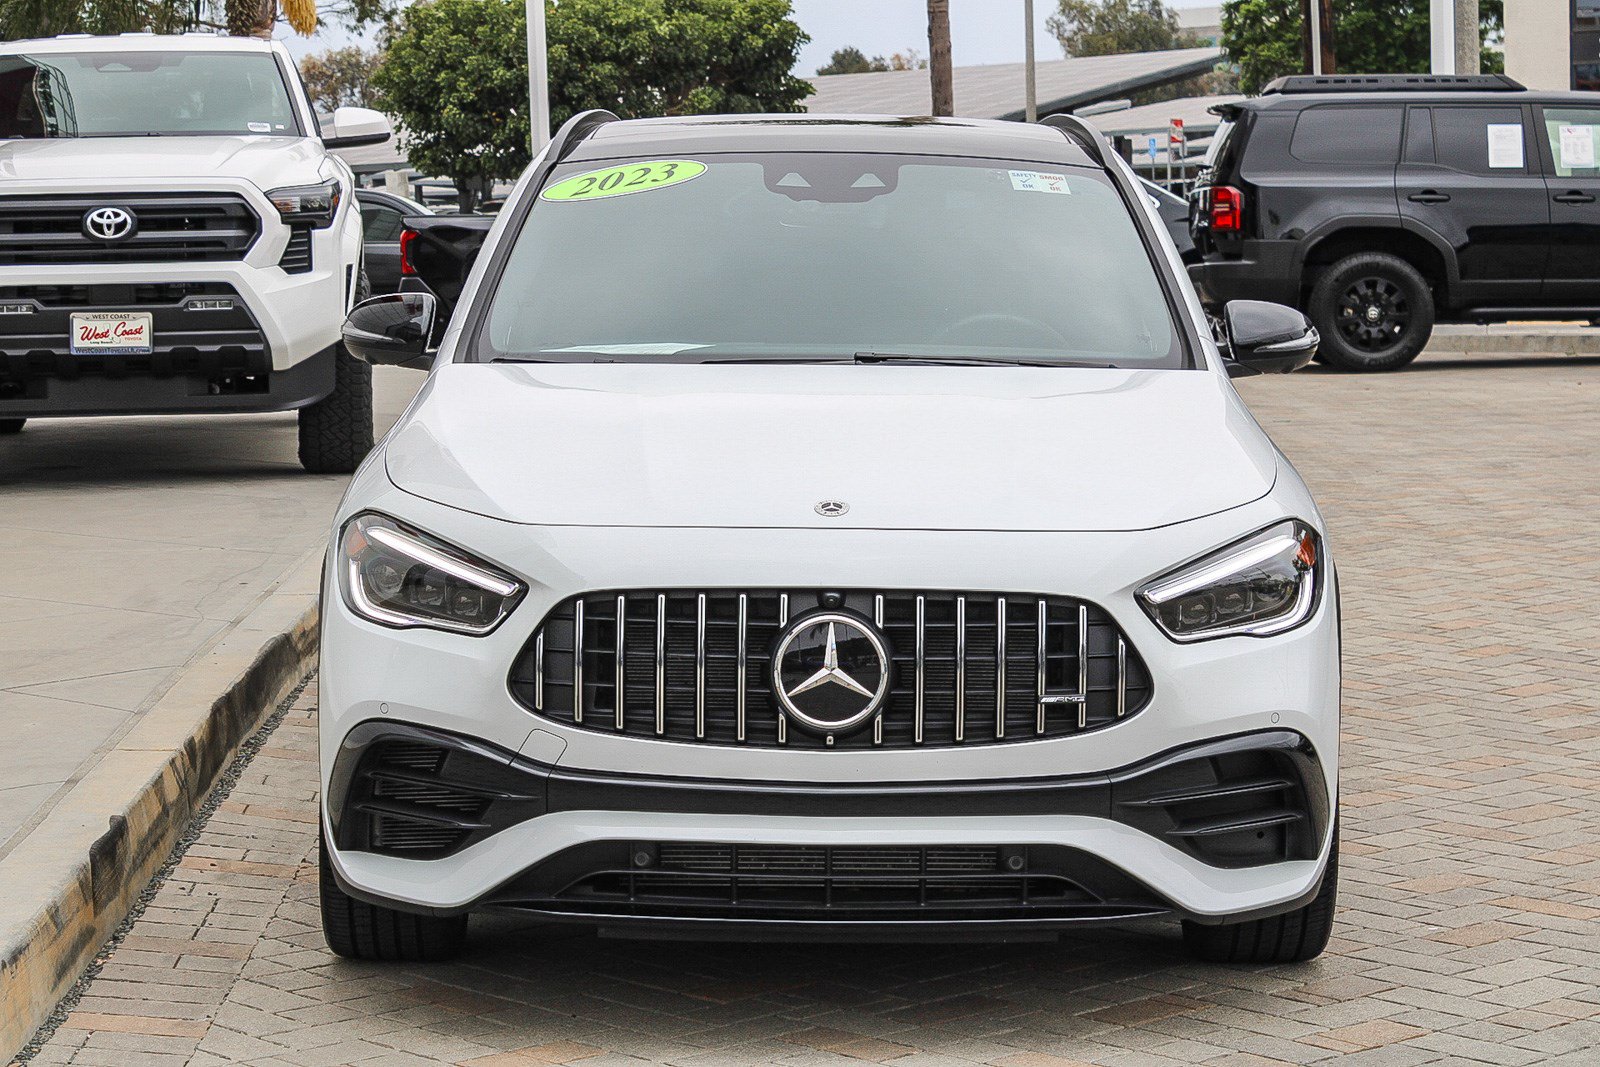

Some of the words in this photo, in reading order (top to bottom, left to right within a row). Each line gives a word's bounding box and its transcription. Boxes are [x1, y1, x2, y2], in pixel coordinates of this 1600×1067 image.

[569, 163, 679, 197] 2023
[80, 326, 110, 341] West
[113, 321, 144, 337] Coast
